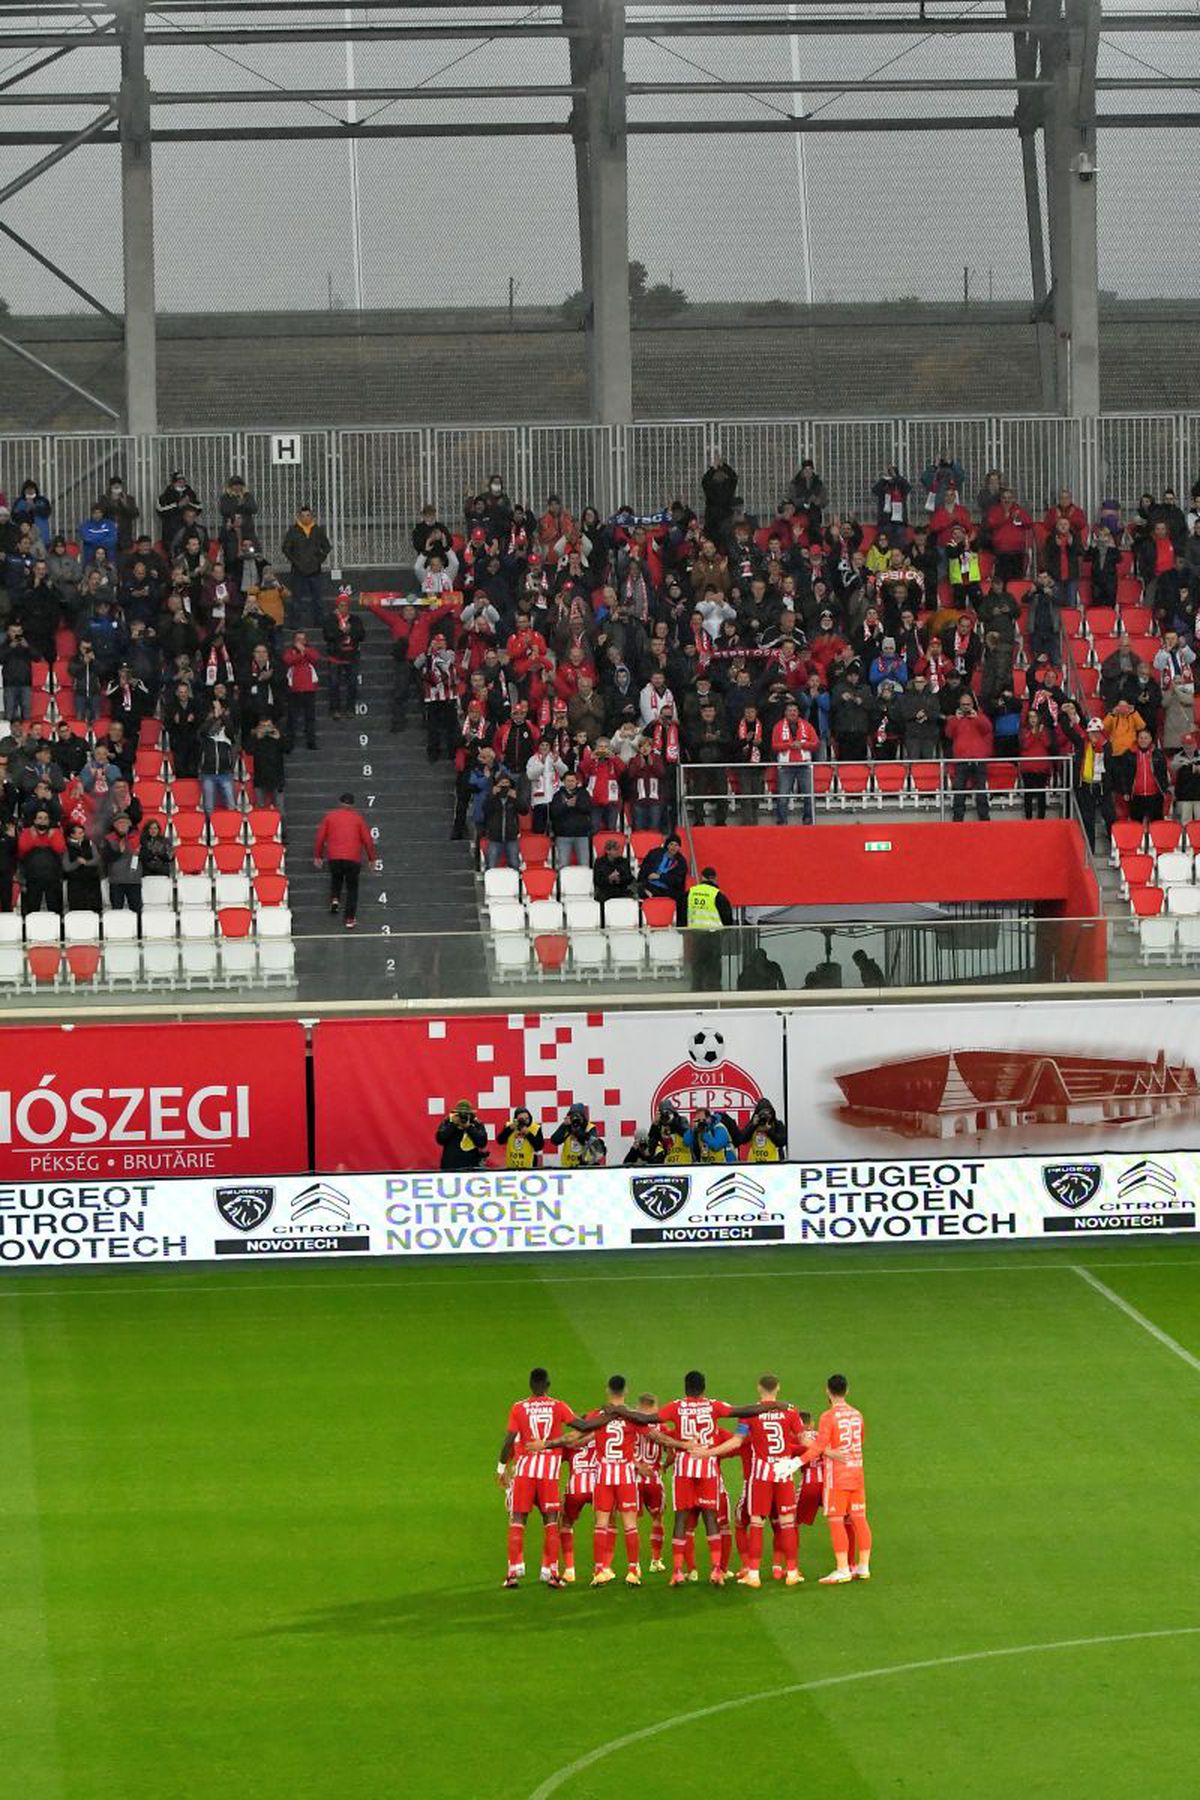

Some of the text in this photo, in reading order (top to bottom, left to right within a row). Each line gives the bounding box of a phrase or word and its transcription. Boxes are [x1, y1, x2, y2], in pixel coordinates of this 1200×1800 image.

[278, 439, 295, 460] H
[355, 703, 368, 715] 10
[359, 734, 369, 746] 9
[362, 764, 373, 776] 8
[367, 796, 376, 807] 7
[370, 827, 380, 840] 6
[374, 859, 384, 871] 5
[378, 892, 388, 904] 4
[381, 925, 391, 937] 3
[386, 959, 396, 971] 2
[692, 1072, 725, 1085] 2011
[672, 1089, 746, 1109] SEPSI
[30, 1151, 216, 1172] PÉKSÉG BRUTĂRIE
[801, 1164, 984, 1188] PEUGEOT
[386, 1174, 572, 1199] PEUGEOT
[800, 1184, 974, 1214] CITROËN
[385, 1195, 561, 1225] CITROËN
[801, 1213, 1016, 1239] NOVOTECH
[1074, 1216, 1164, 1229] NOVOTECH
[386, 1224, 604, 1250] NOVOTECH
[662, 1228, 753, 1240] NOVOTECH
[246, 1238, 338, 1252] NOVOTECH
[529, 1414, 553, 1442] 17
[605, 1424, 624, 1459] 2
[763, 1421, 785, 1454] 3
